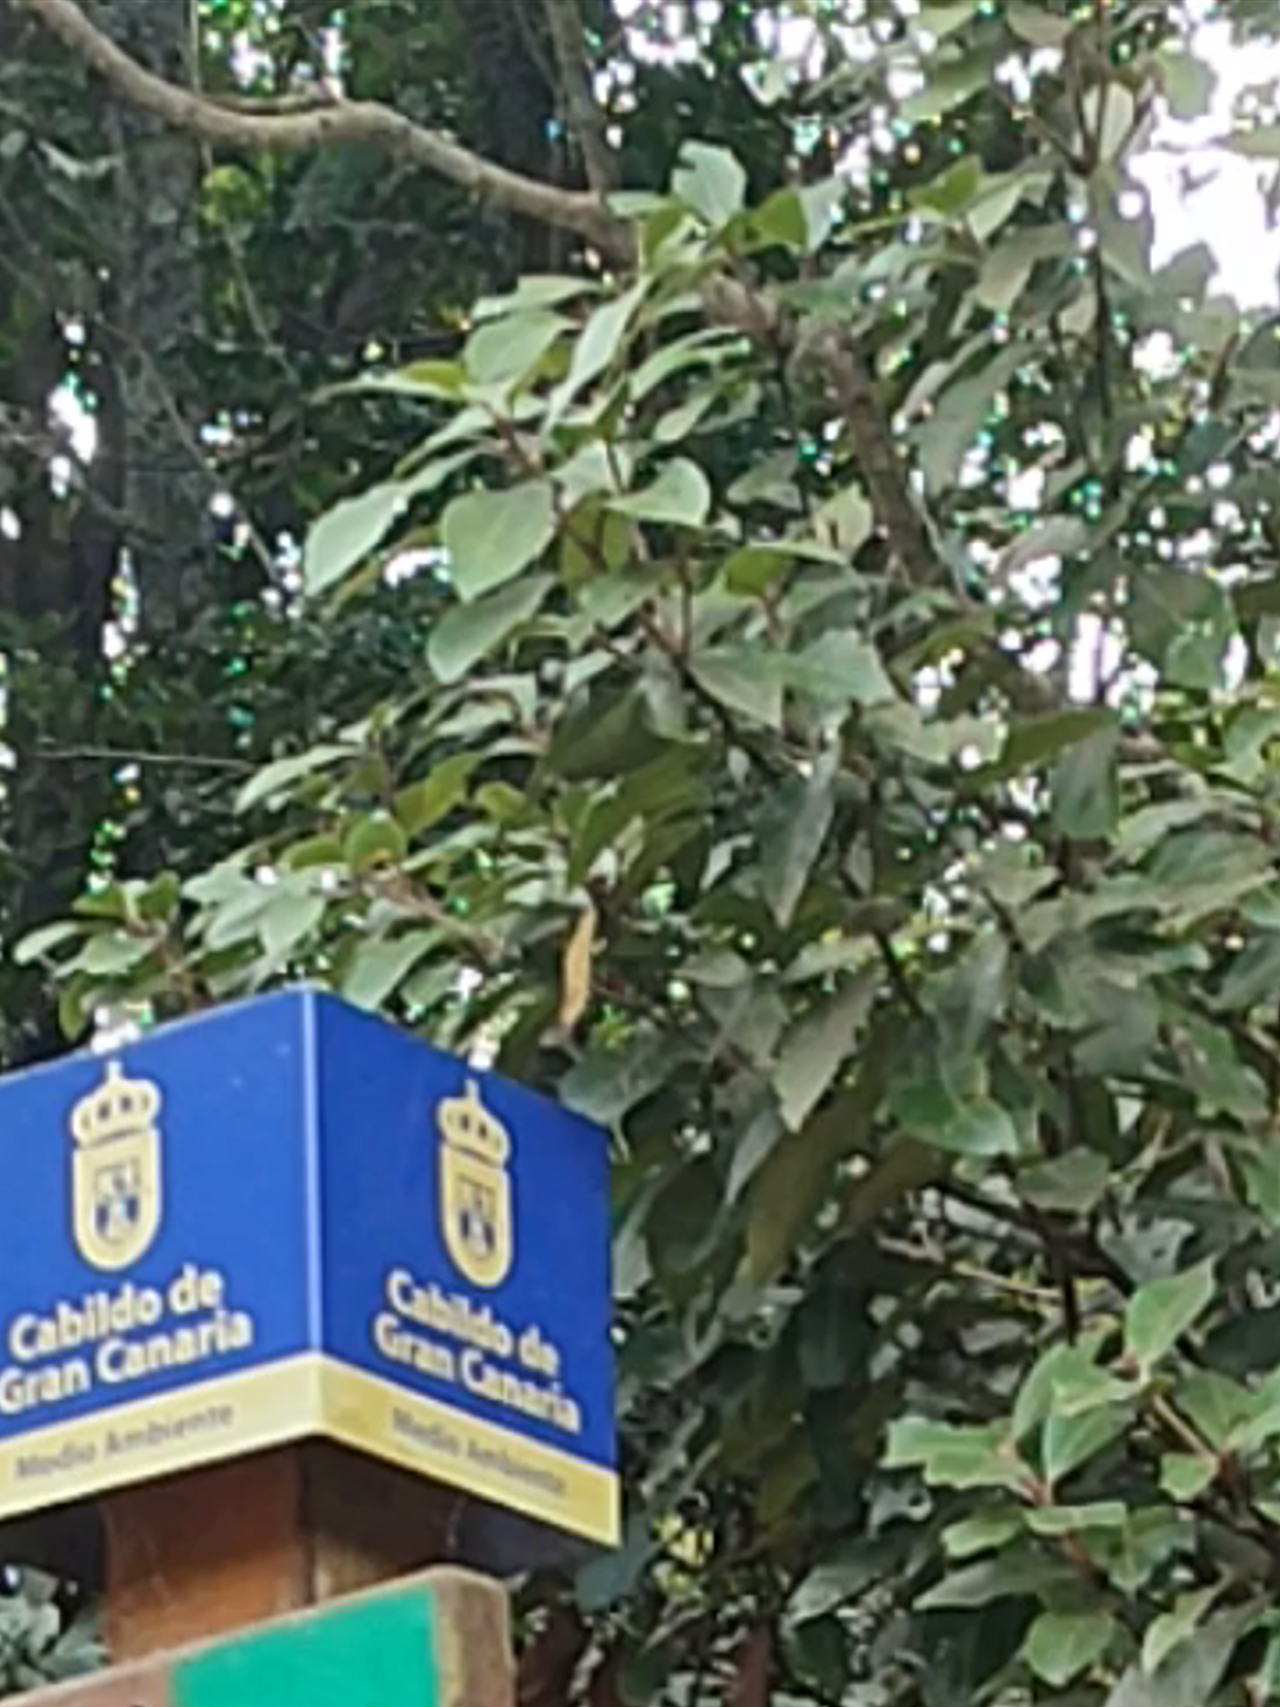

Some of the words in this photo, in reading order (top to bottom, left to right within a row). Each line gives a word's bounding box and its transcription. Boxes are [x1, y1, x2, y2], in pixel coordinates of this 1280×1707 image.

[9, 1281, 162, 1361] Cabildo
[169, 1262, 224, 1314] de
[96, 1309, 252, 1383] Canaria
[387, 1267, 514, 1357] Cabildo
[519, 1323, 559, 1377] de
[375, 1311, 455, 1381] Gran
[461, 1348, 581, 1434] Canaria
[15, 1441, 96, 1479] Medio
[106, 1404, 233, 1456] Ambiente
